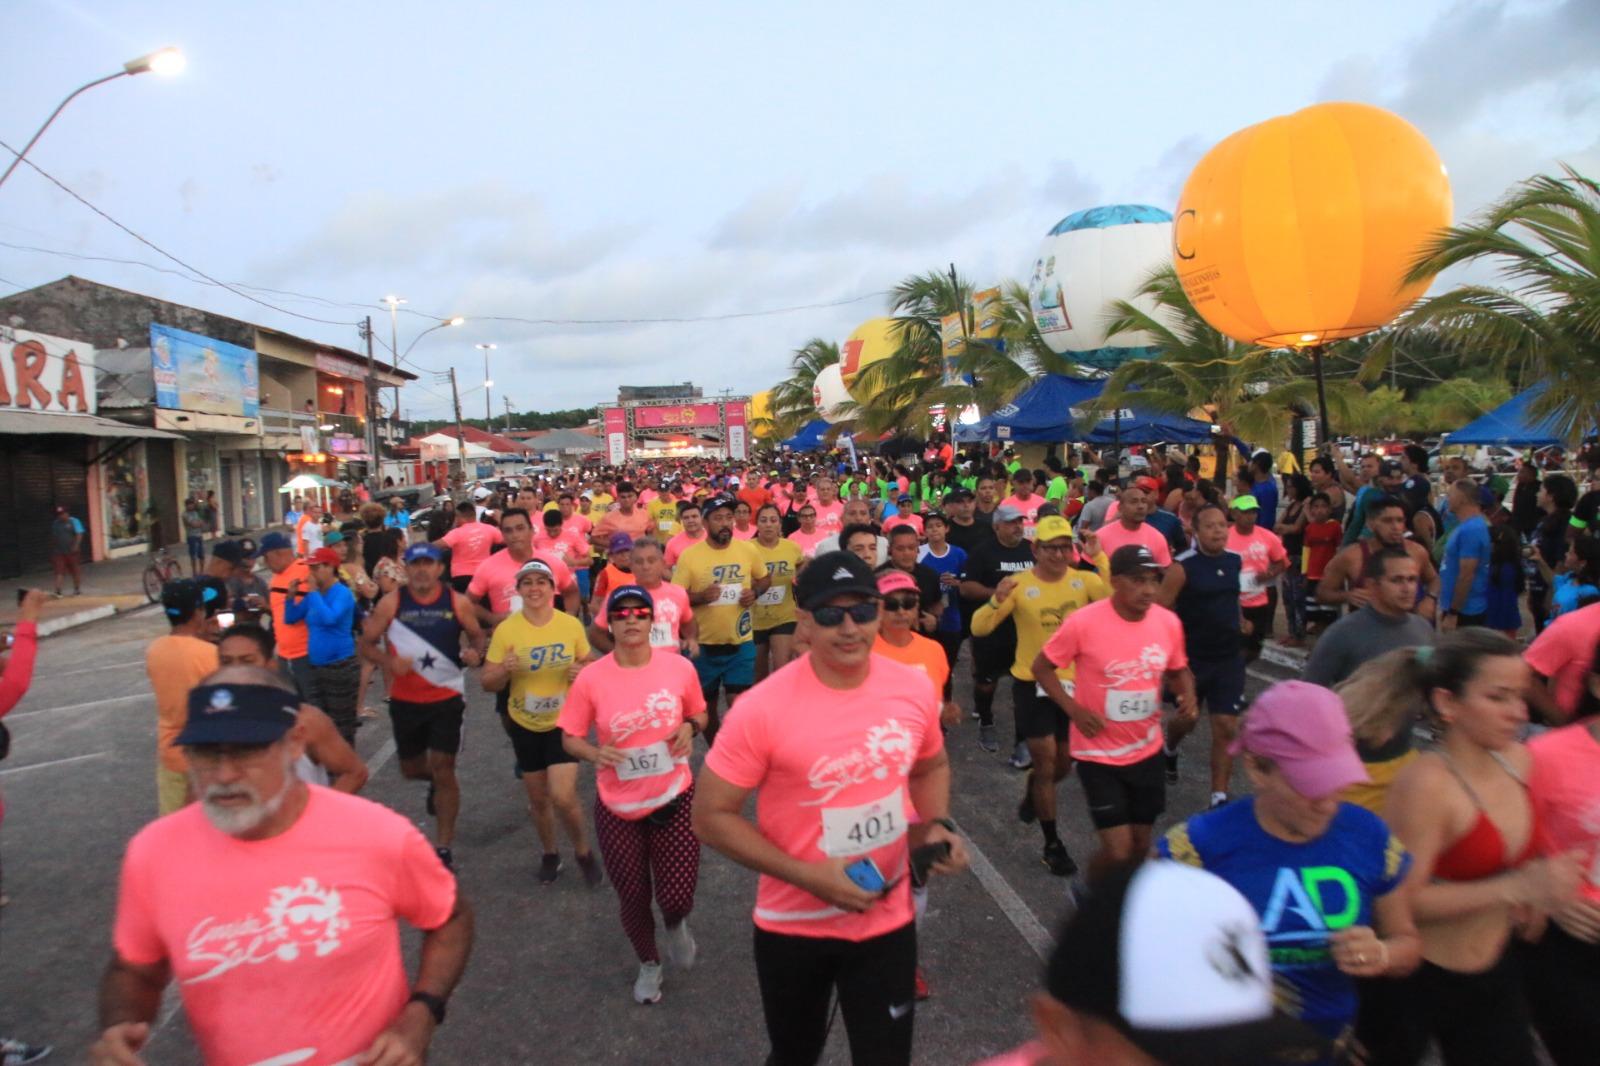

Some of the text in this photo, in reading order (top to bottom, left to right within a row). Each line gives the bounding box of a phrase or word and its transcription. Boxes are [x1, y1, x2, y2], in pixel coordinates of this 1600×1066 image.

[719, 588, 736, 600] 49
[628, 753, 658, 771] 167
[847, 811, 894, 843] 401
[1262, 866, 1361, 932] AD
